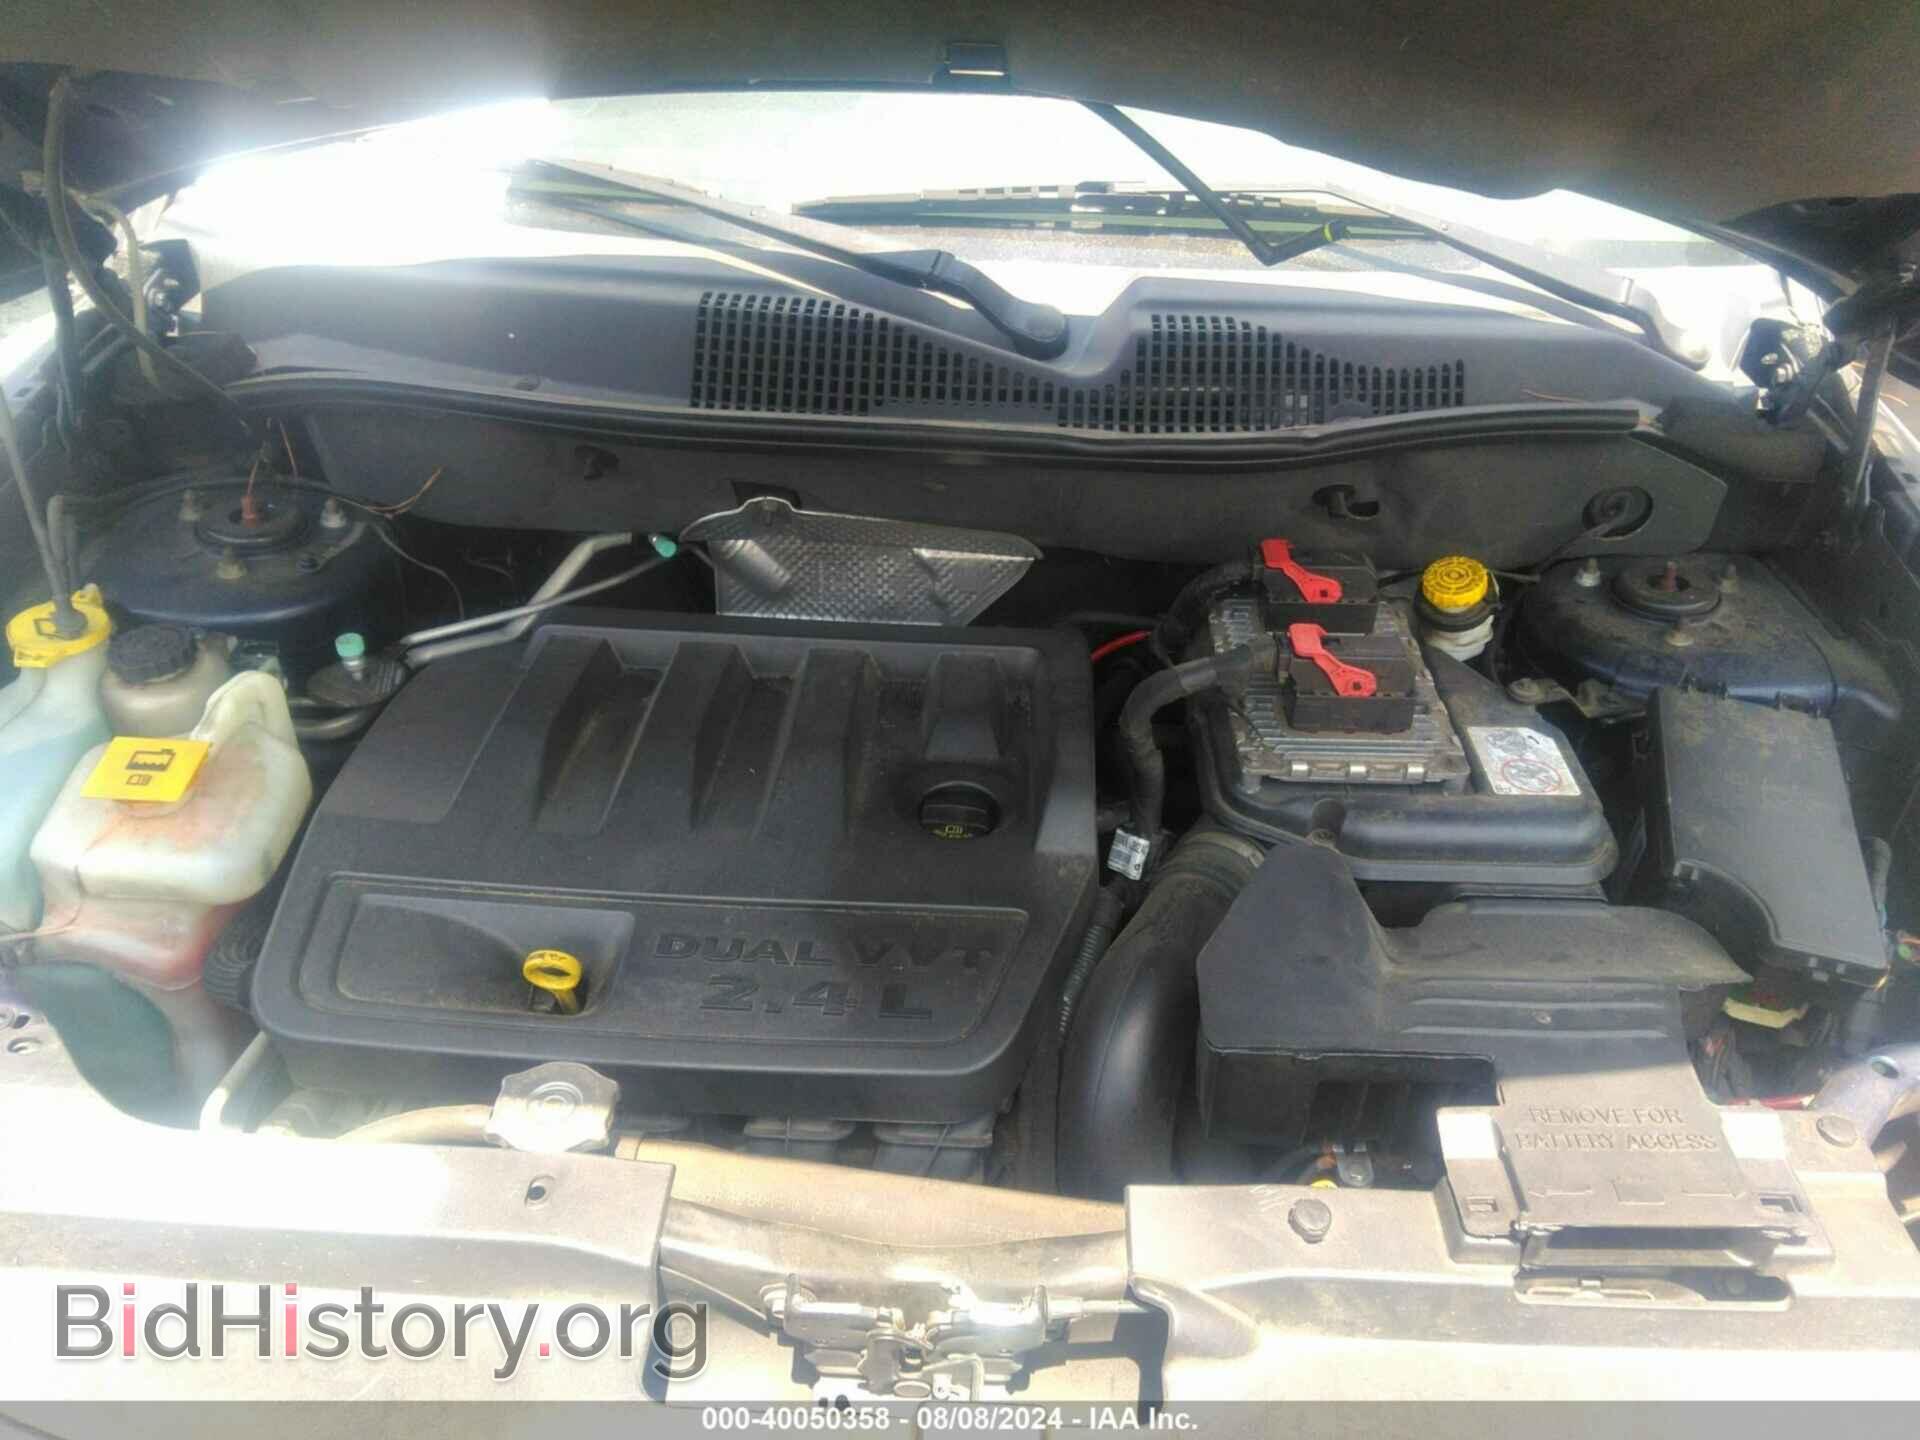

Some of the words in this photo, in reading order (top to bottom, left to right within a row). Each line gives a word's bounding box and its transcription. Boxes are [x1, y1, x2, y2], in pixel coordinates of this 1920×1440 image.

[655, 934, 832, 966] DUAL
[1528, 1107, 1626, 1125] REMOVE
[1631, 1107, 1684, 1125] FOR
[1515, 1132, 1616, 1150] BATTERY
[1626, 1132, 1719, 1151] ACCESS
